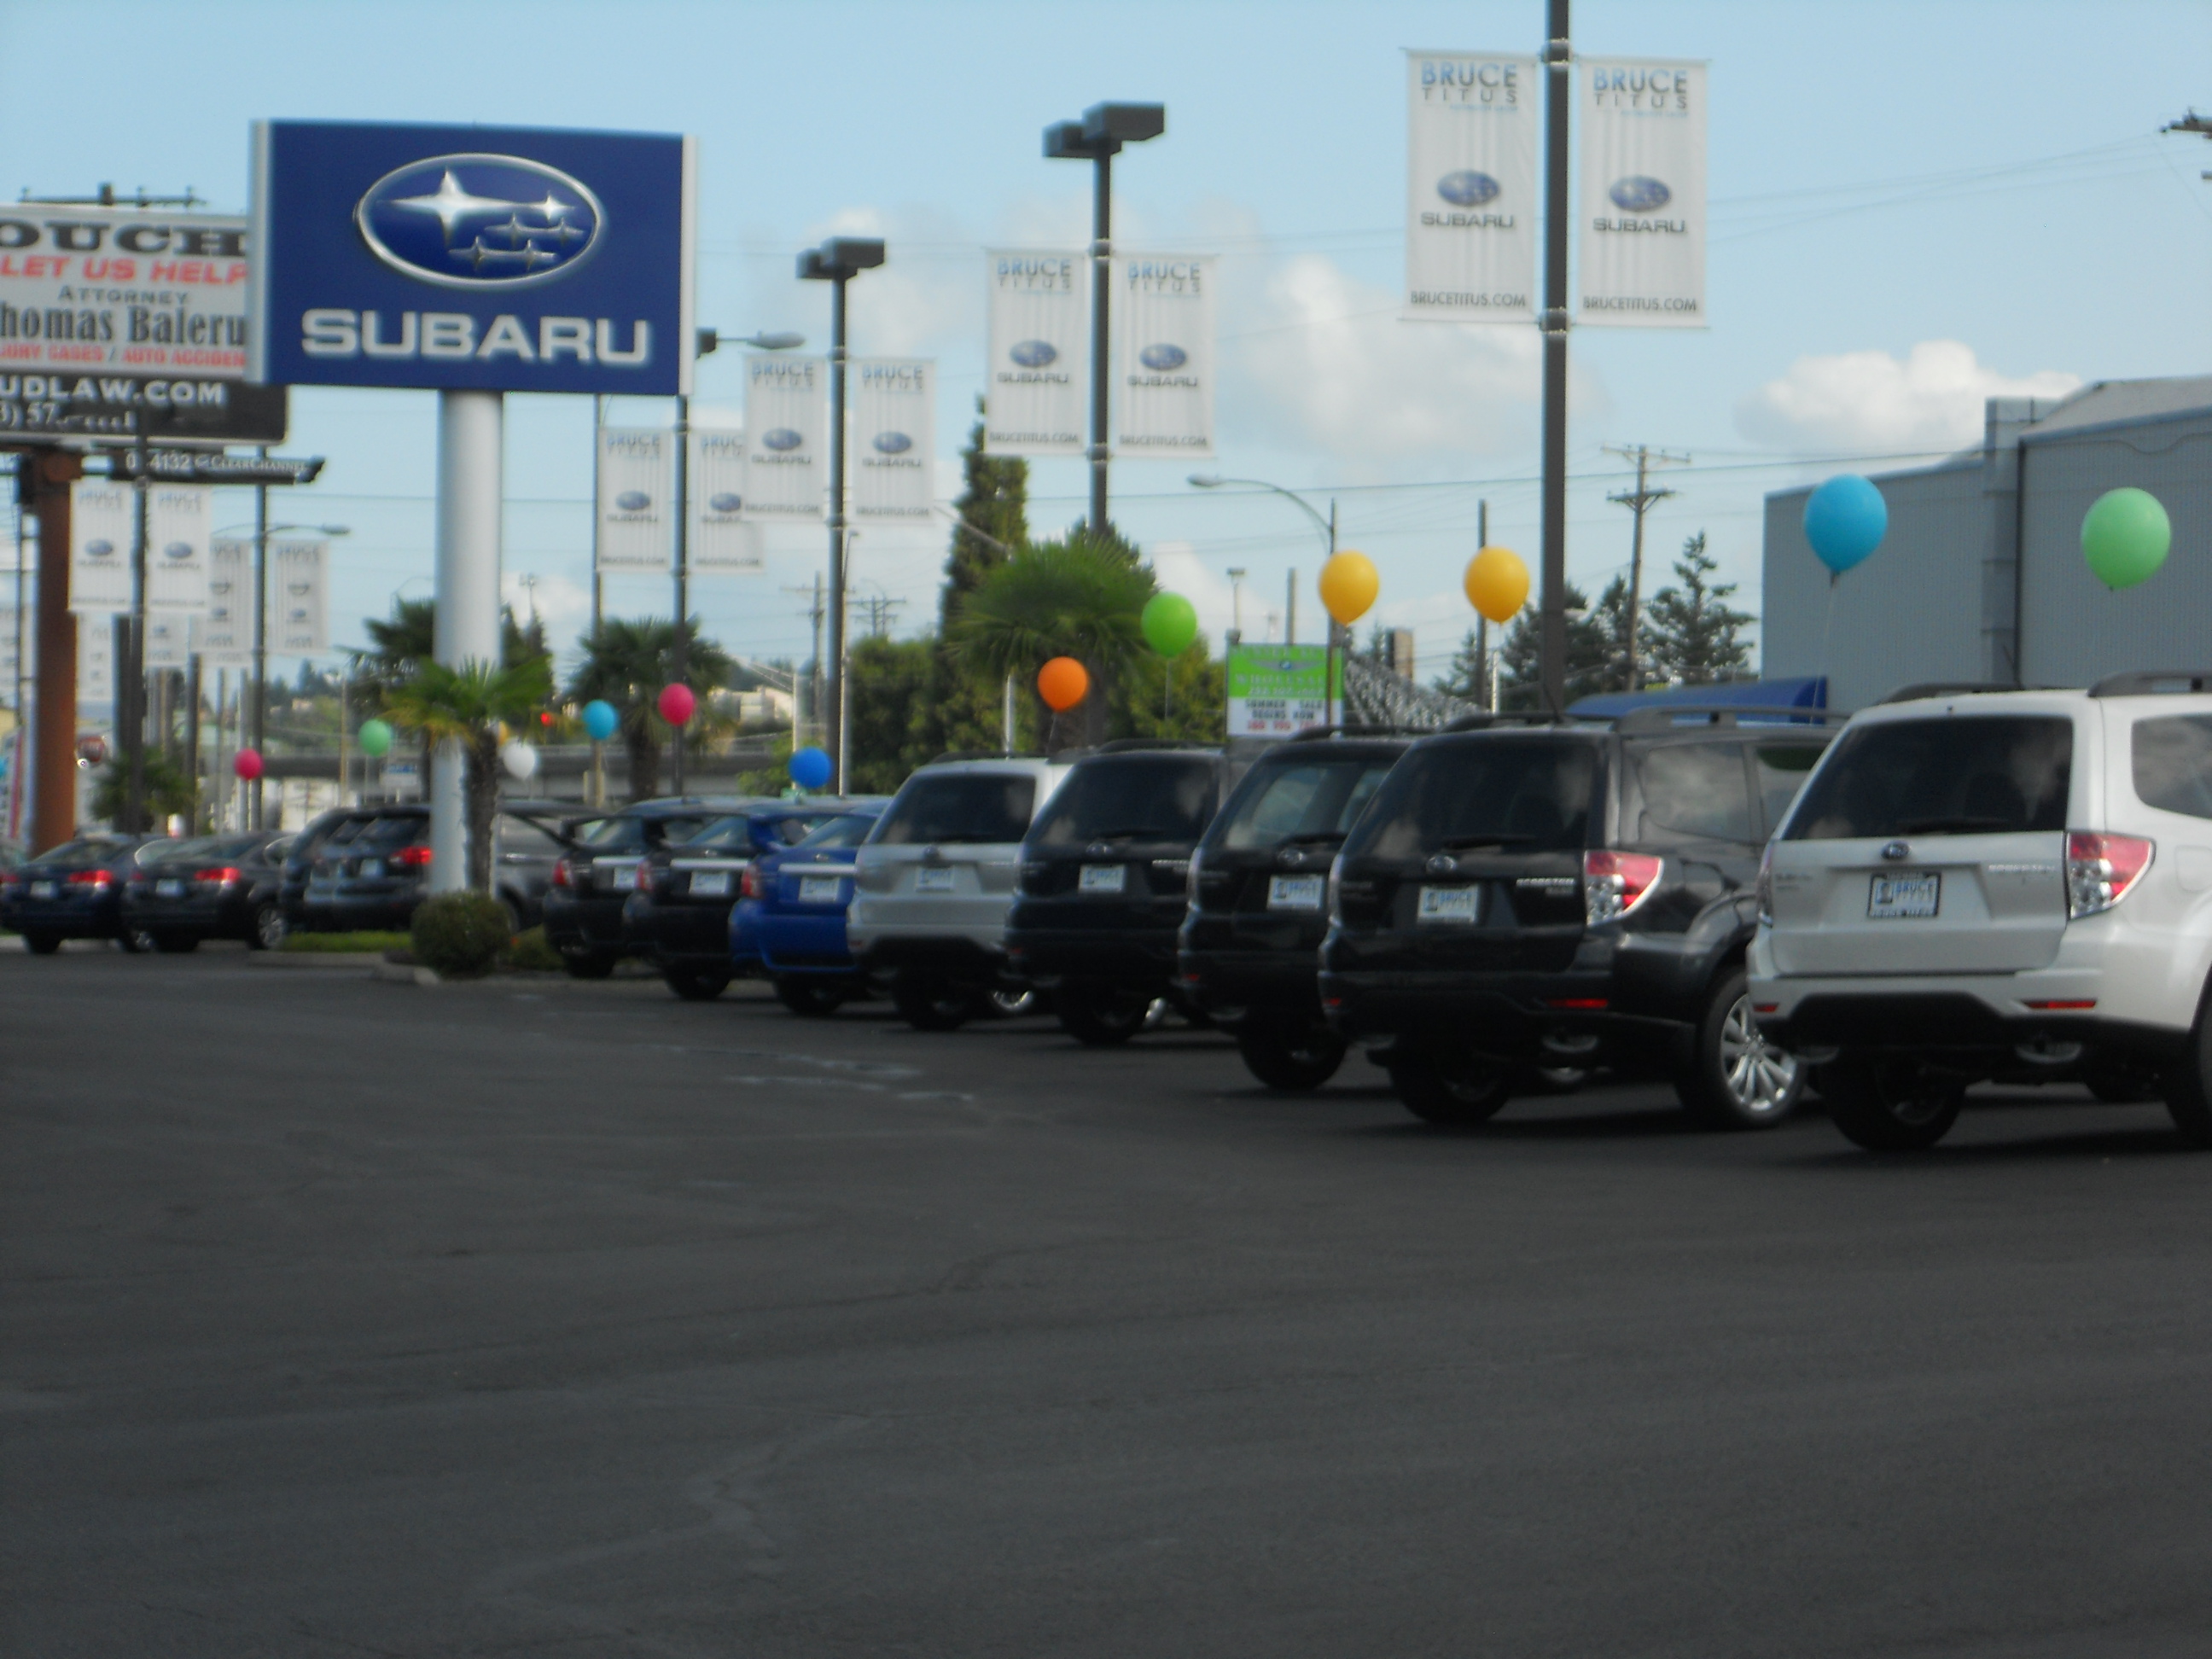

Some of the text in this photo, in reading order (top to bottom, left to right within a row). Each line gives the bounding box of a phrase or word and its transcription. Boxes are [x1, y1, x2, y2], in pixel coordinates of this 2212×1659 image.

[1421, 61, 1517, 87] BRUCE
[1593, 67, 1688, 93] BRUCE
[1423, 87, 1517, 104] TITUS
[1594, 93, 1687, 110] TITUS
[1420, 212, 1515, 230] SUBARU
[1592, 218, 1687, 234] SUBARU
[0, 255, 247, 285] LET US HELP
[997, 258, 1072, 276] BRUCE
[1127, 261, 1201, 281] BRUCE
[998, 276, 1072, 289] TITUS
[1128, 280, 1201, 293] TITUS
[57, 285, 189, 306] ATTORNEY
[1411, 290, 1526, 308] BRUCETITUS.COM
[1583, 295, 1697, 312] BRUCETITUS.COM
[300, 307, 652, 367] SUBARU
[121, 346, 167, 364] AUTO
[752, 362, 814, 377] BRUCE
[862, 364, 924, 380] BRUCE
[997, 372, 1069, 384] SUBARU
[1126, 375, 1199, 387] SUBARU
[701, 434, 744, 448] BRUC
